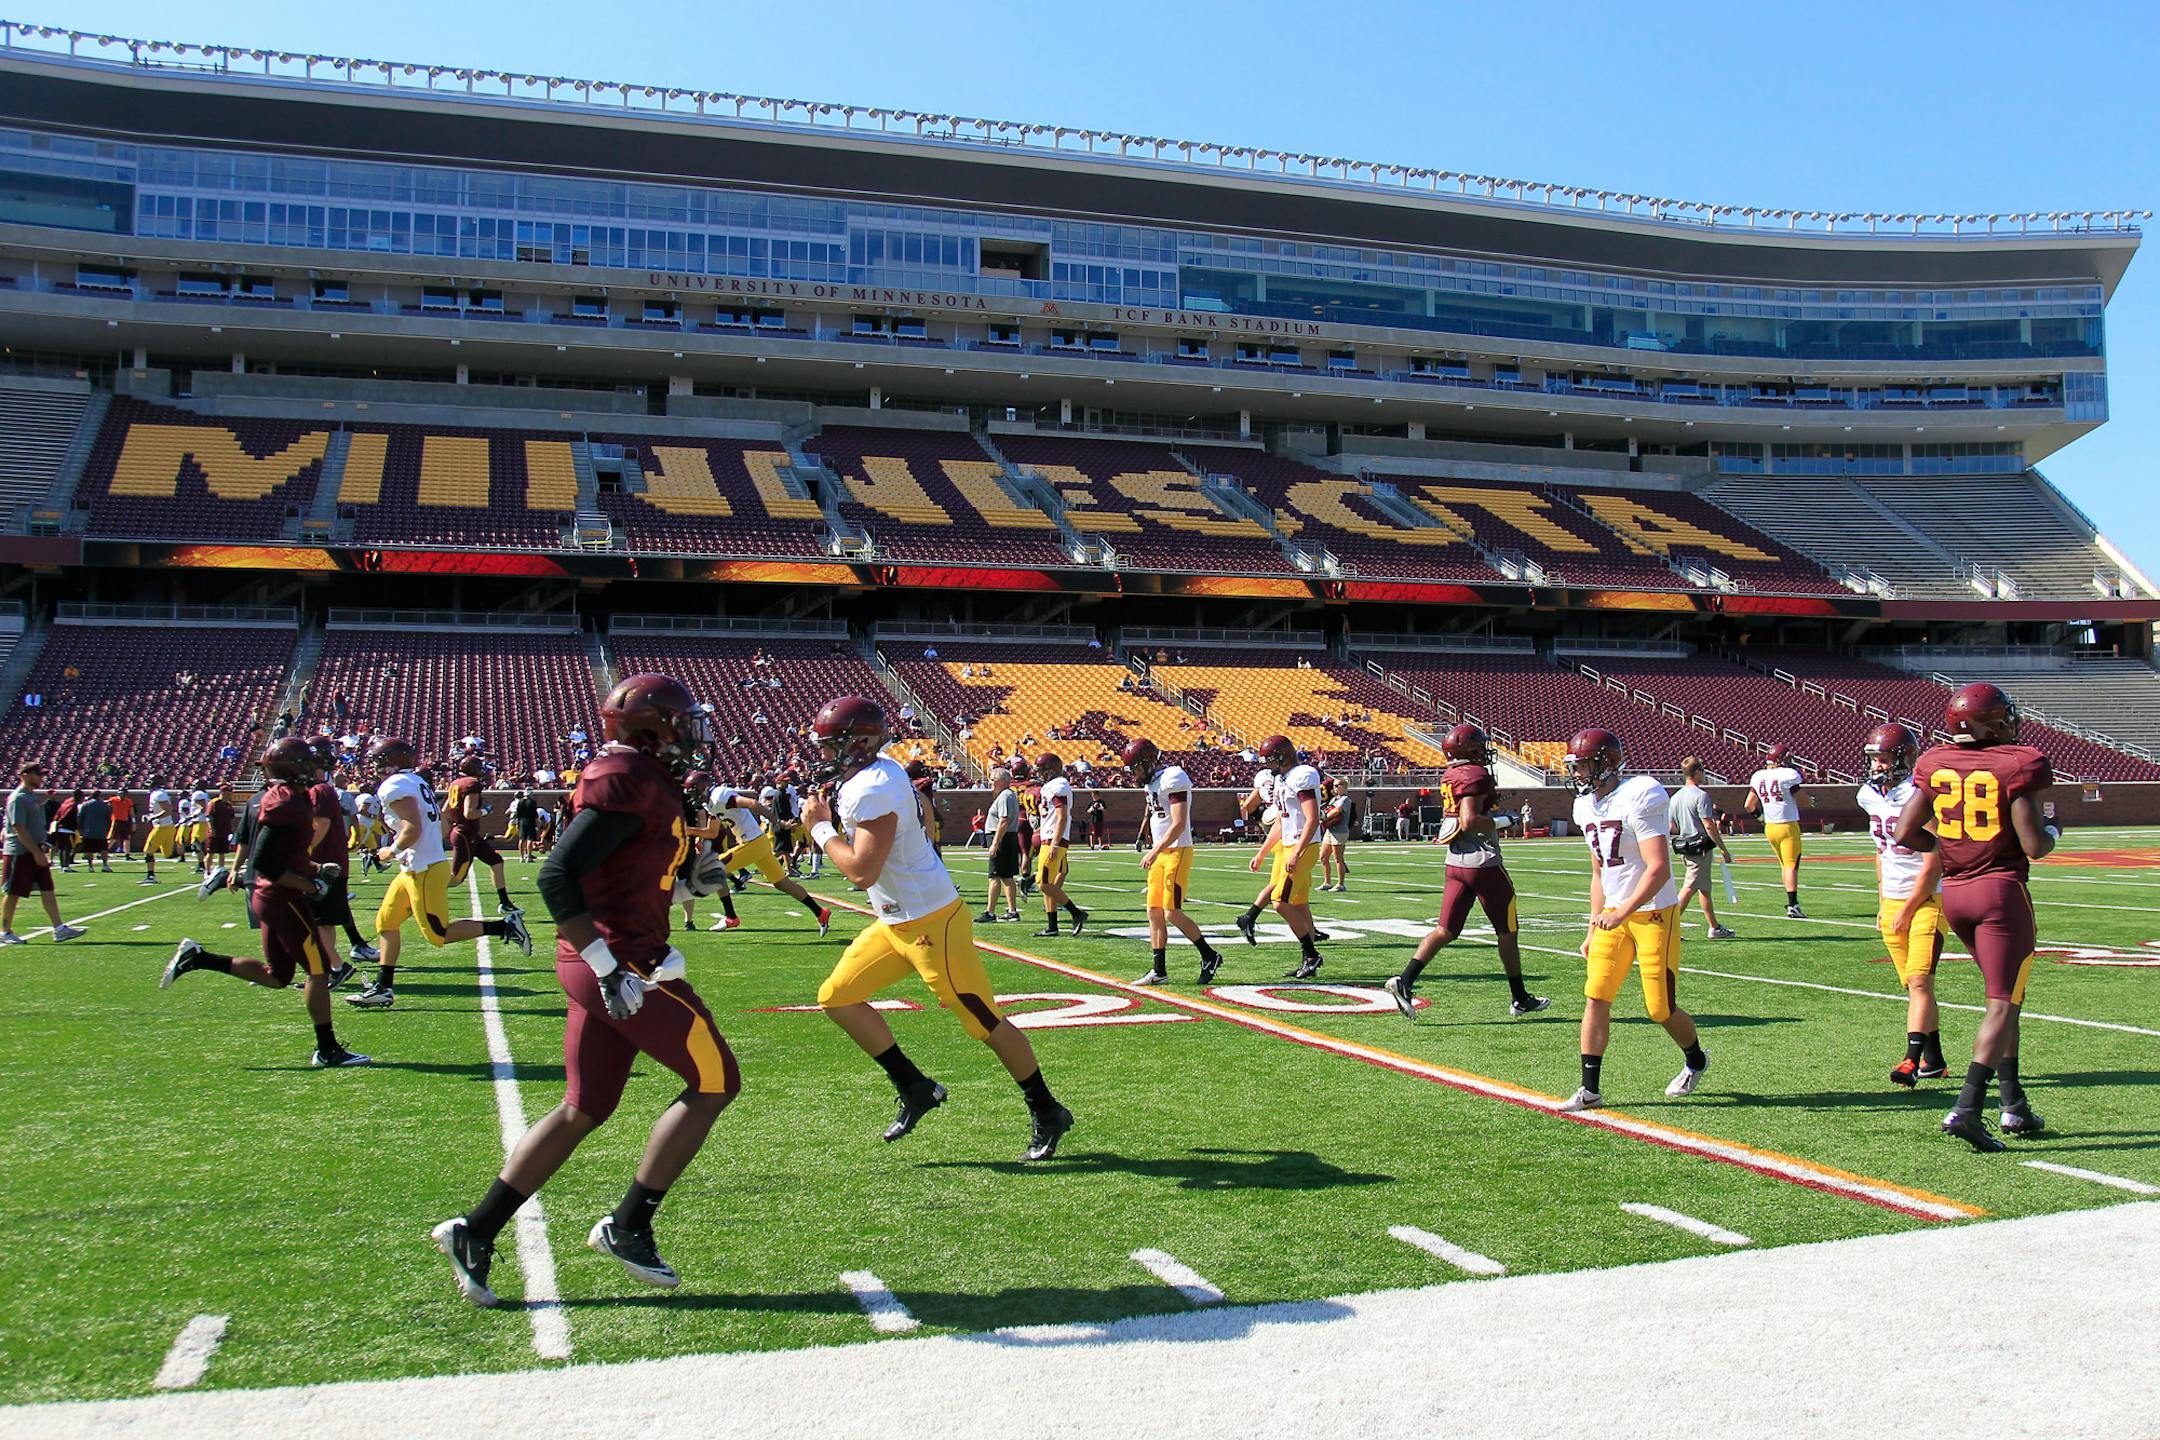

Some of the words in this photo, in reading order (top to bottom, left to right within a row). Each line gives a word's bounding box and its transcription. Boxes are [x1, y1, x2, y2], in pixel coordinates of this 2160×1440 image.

[649, 273, 799, 295] UNIVERSITY
[813, 285, 839, 298] OF
[853, 288, 987, 309] MINNESOTA
[1112, 308, 1151, 321] TCF
[1164, 315, 1218, 327] BANK
[1230, 317, 1321, 335] STADIUM
[1759, 780, 1784, 803] 44
[1930, 768, 2001, 842] 28
[940, 983, 1433, 1031] 20
